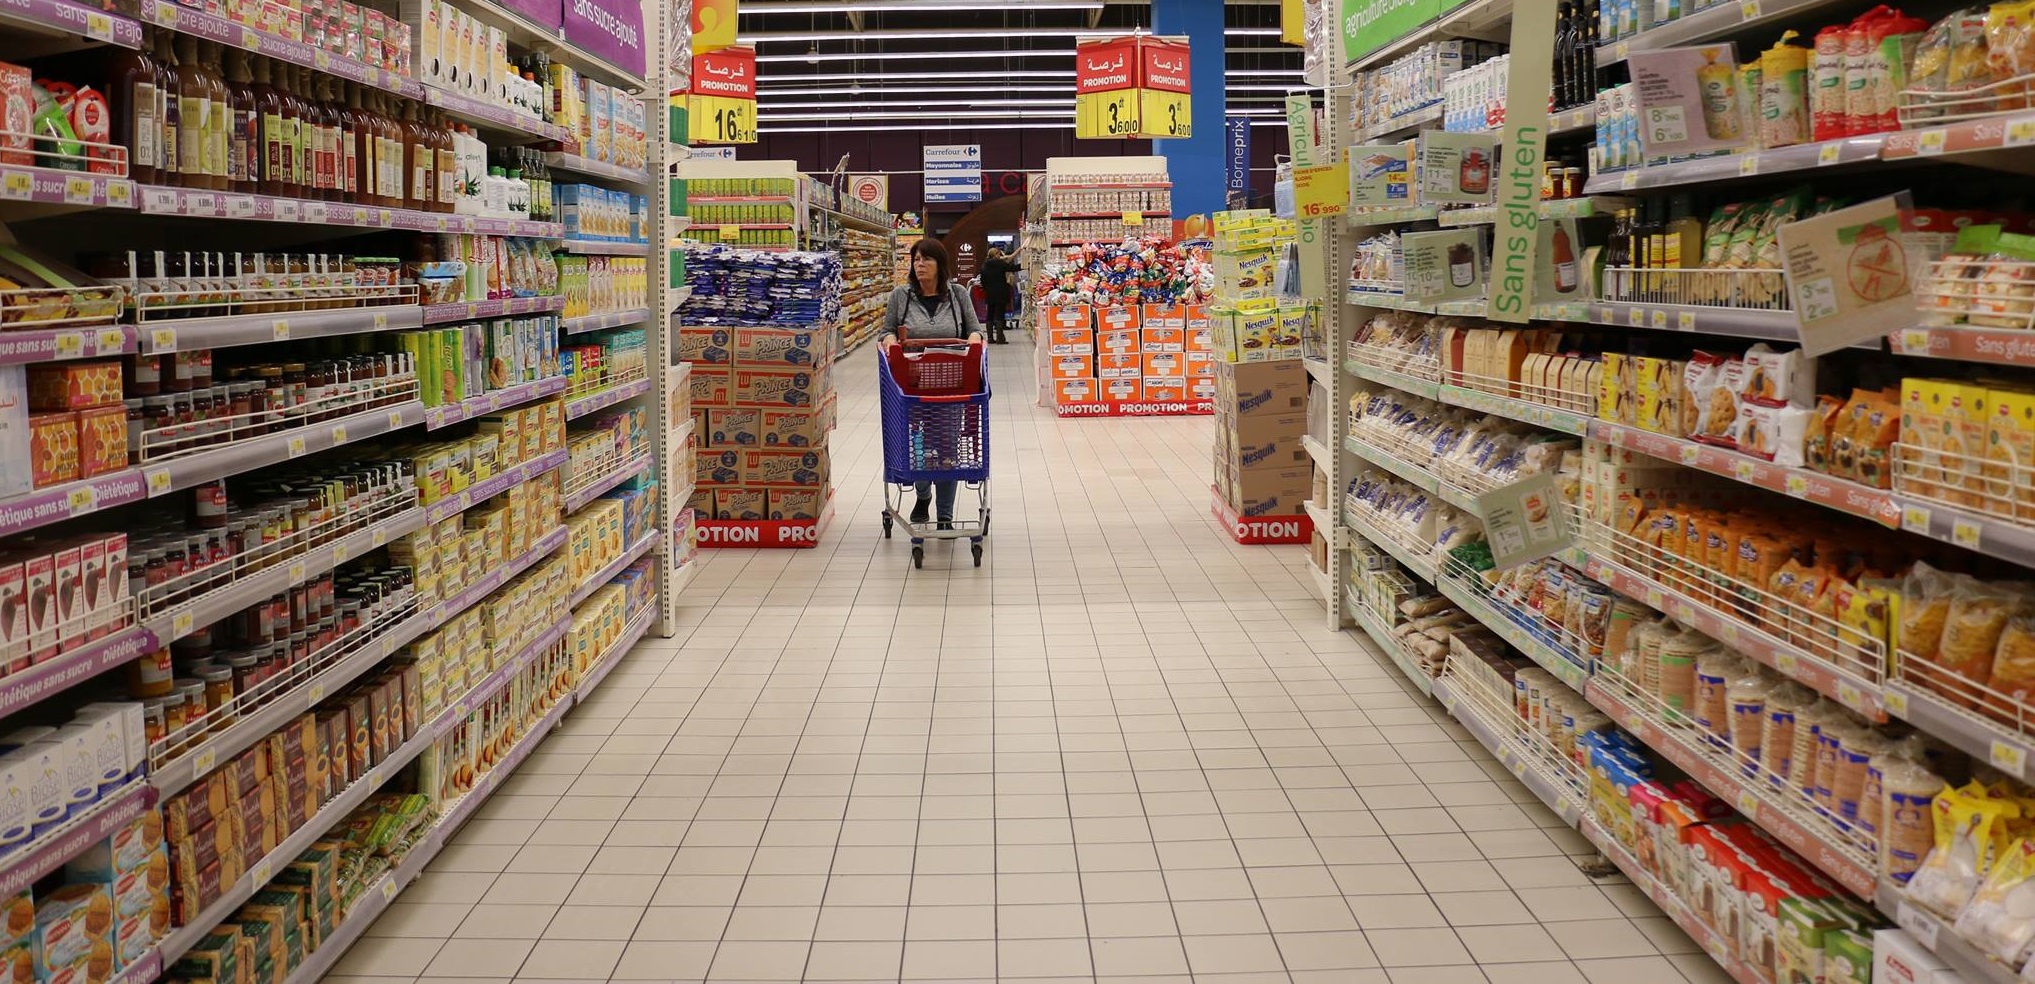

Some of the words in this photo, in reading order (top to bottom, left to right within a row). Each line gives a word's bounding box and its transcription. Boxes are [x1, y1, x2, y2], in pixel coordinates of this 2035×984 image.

[55, 2, 87, 24] sans
[594, 6, 615, 36] sucre
[199, 14, 229, 38] ajouté
[263, 37, 285, 54] sucre
[285, 44, 312, 63] ajouté
[704, 60, 744, 79] فرصة
[1087, 53, 1123, 72] فرصة
[1153, 54, 1183, 73] فرصة
[701, 80, 748, 92] PROMOTION
[1083, 75, 1126, 87] PROMOTION
[1150, 74, 1186, 86] PROMOTION
[715, 109, 737, 141] 16
[1109, 103, 1118, 134] 3
[1117, 120, 1137, 133] 600
[1169, 104, 1176, 134] 3
[1177, 124, 1190, 135] 600
[1652, 109, 1662, 123] 8
[1655, 128, 1665, 141] 6
[1231, 119, 1246, 188] Borneprix
[1504, 126, 1537, 231] gluten
[1303, 203, 1320, 216] 16
[1323, 205, 1340, 213] 990
[1239, 254, 1268, 270] Nesquik
[1495, 236, 1528, 314] Sans
[1245, 315, 1275, 331] Nesquik
[1282, 318, 1300, 328] Nesq
[16, 340, 40, 353] sans
[41, 339, 56, 352] suc
[680, 336, 709, 350] RINCE
[741, 333, 750, 343] LU
[755, 337, 792, 356] PRINCE
[1976, 336, 2005, 354] Sans
[740, 374, 750, 384] LU
[754, 379, 791, 397] PRINCE
[1058, 403, 1110, 415] OMOTION
[1119, 402, 1187, 413] PROMOTION
[1239, 389, 1273, 413] Nesquik
[725, 414, 753, 428] PRINCE
[779, 416, 806, 430] PRINCE
[750, 454, 758, 463] LU
[1242, 443, 1276, 466] Nesquik
[763, 458, 799, 476] PRINCE
[95, 481, 140, 501] Diététique
[731, 493, 758, 507] PRINCE
[783, 494, 811, 508] PRINCE
[1244, 497, 1278, 517] Nesquik
[0, 507, 33, 526] étique
[34, 501, 58, 517] sans
[696, 526, 759, 542] OTION
[1237, 521, 1299, 538] OTION
[102, 636, 148, 664] Diététique
[0, 681, 42, 709] ététique
[43, 672, 66, 690] sans
[66, 659, 93, 679] sucre
[40, 851, 62, 870] sans
[63, 831, 90, 854] sucre
